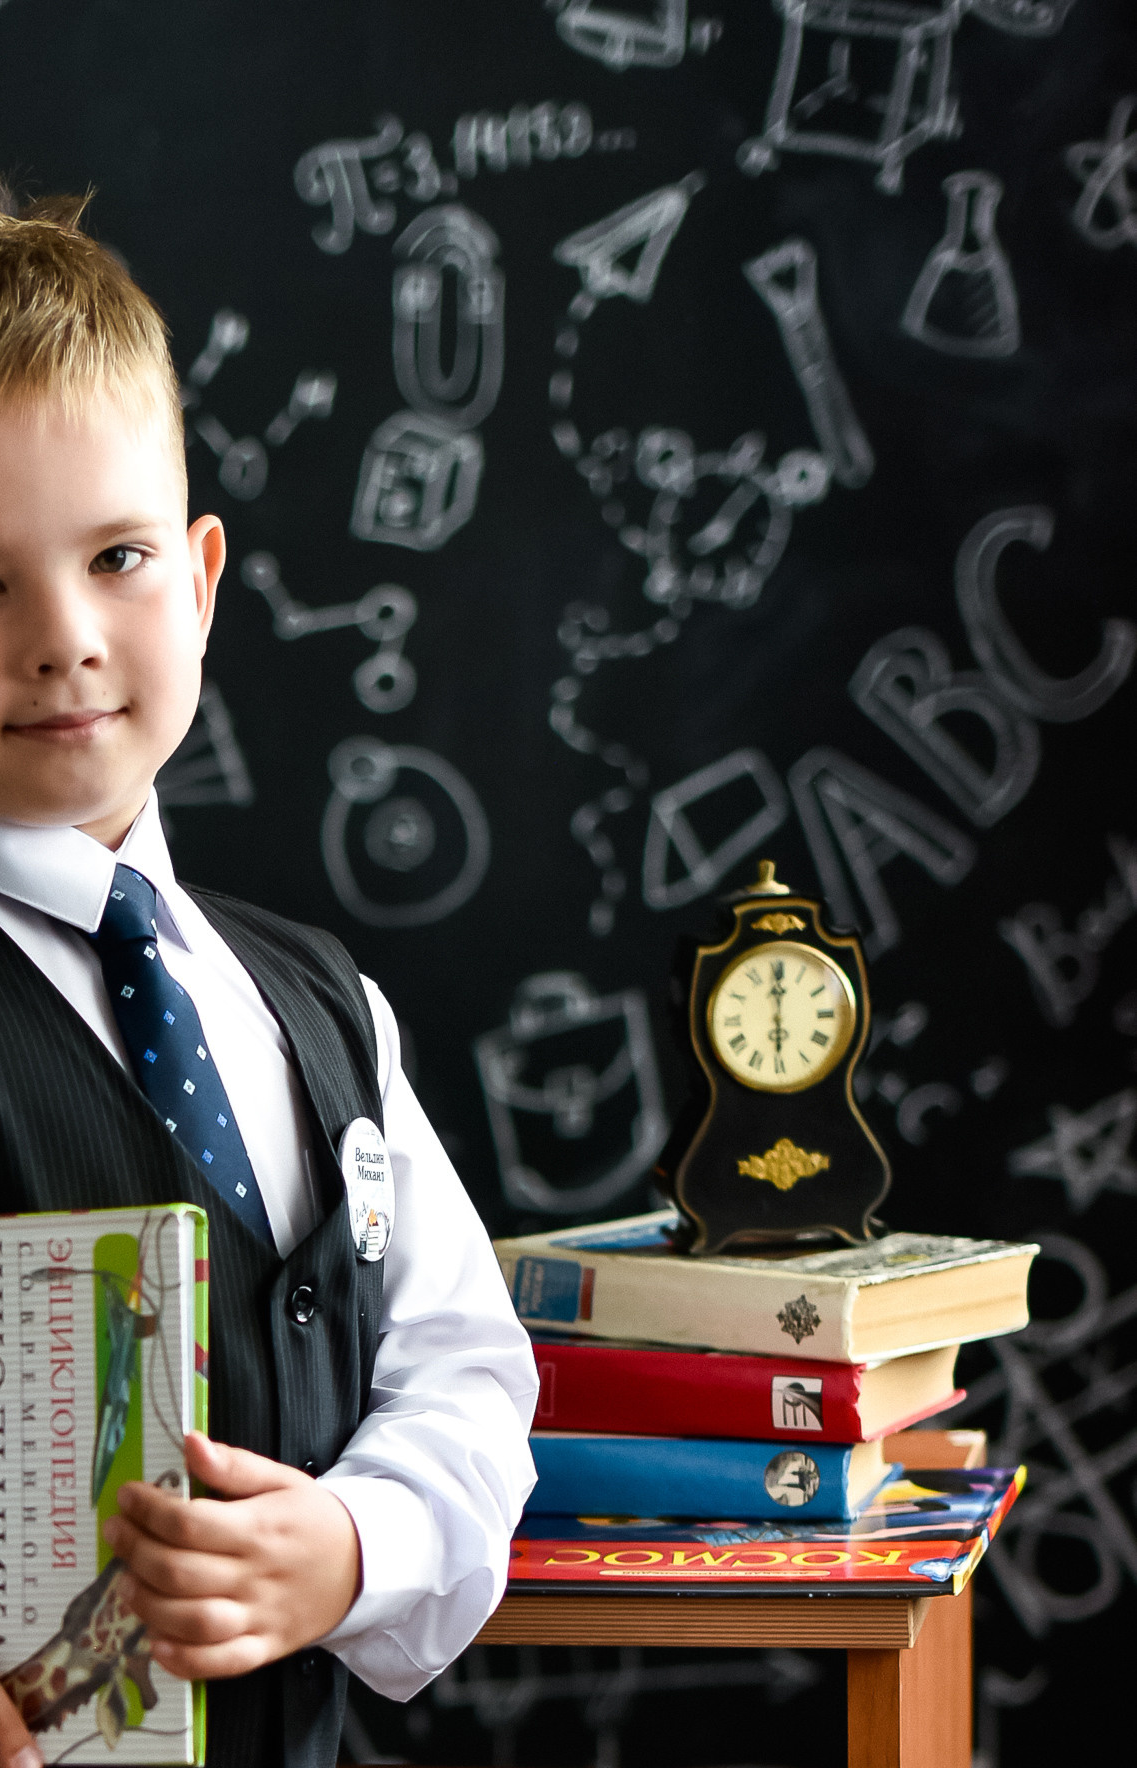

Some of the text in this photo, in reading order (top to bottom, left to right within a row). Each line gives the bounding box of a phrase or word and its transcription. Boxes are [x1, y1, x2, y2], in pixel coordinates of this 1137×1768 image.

[787, 503, 1137, 964] ABC
[18, 1241, 38, 1627] СОВРЕМЕННОГО
[46, 1238, 78, 1570] ЭНЦИКЛОПЕДИЯ
[543, 1549, 909, 1568] КОСМОС
